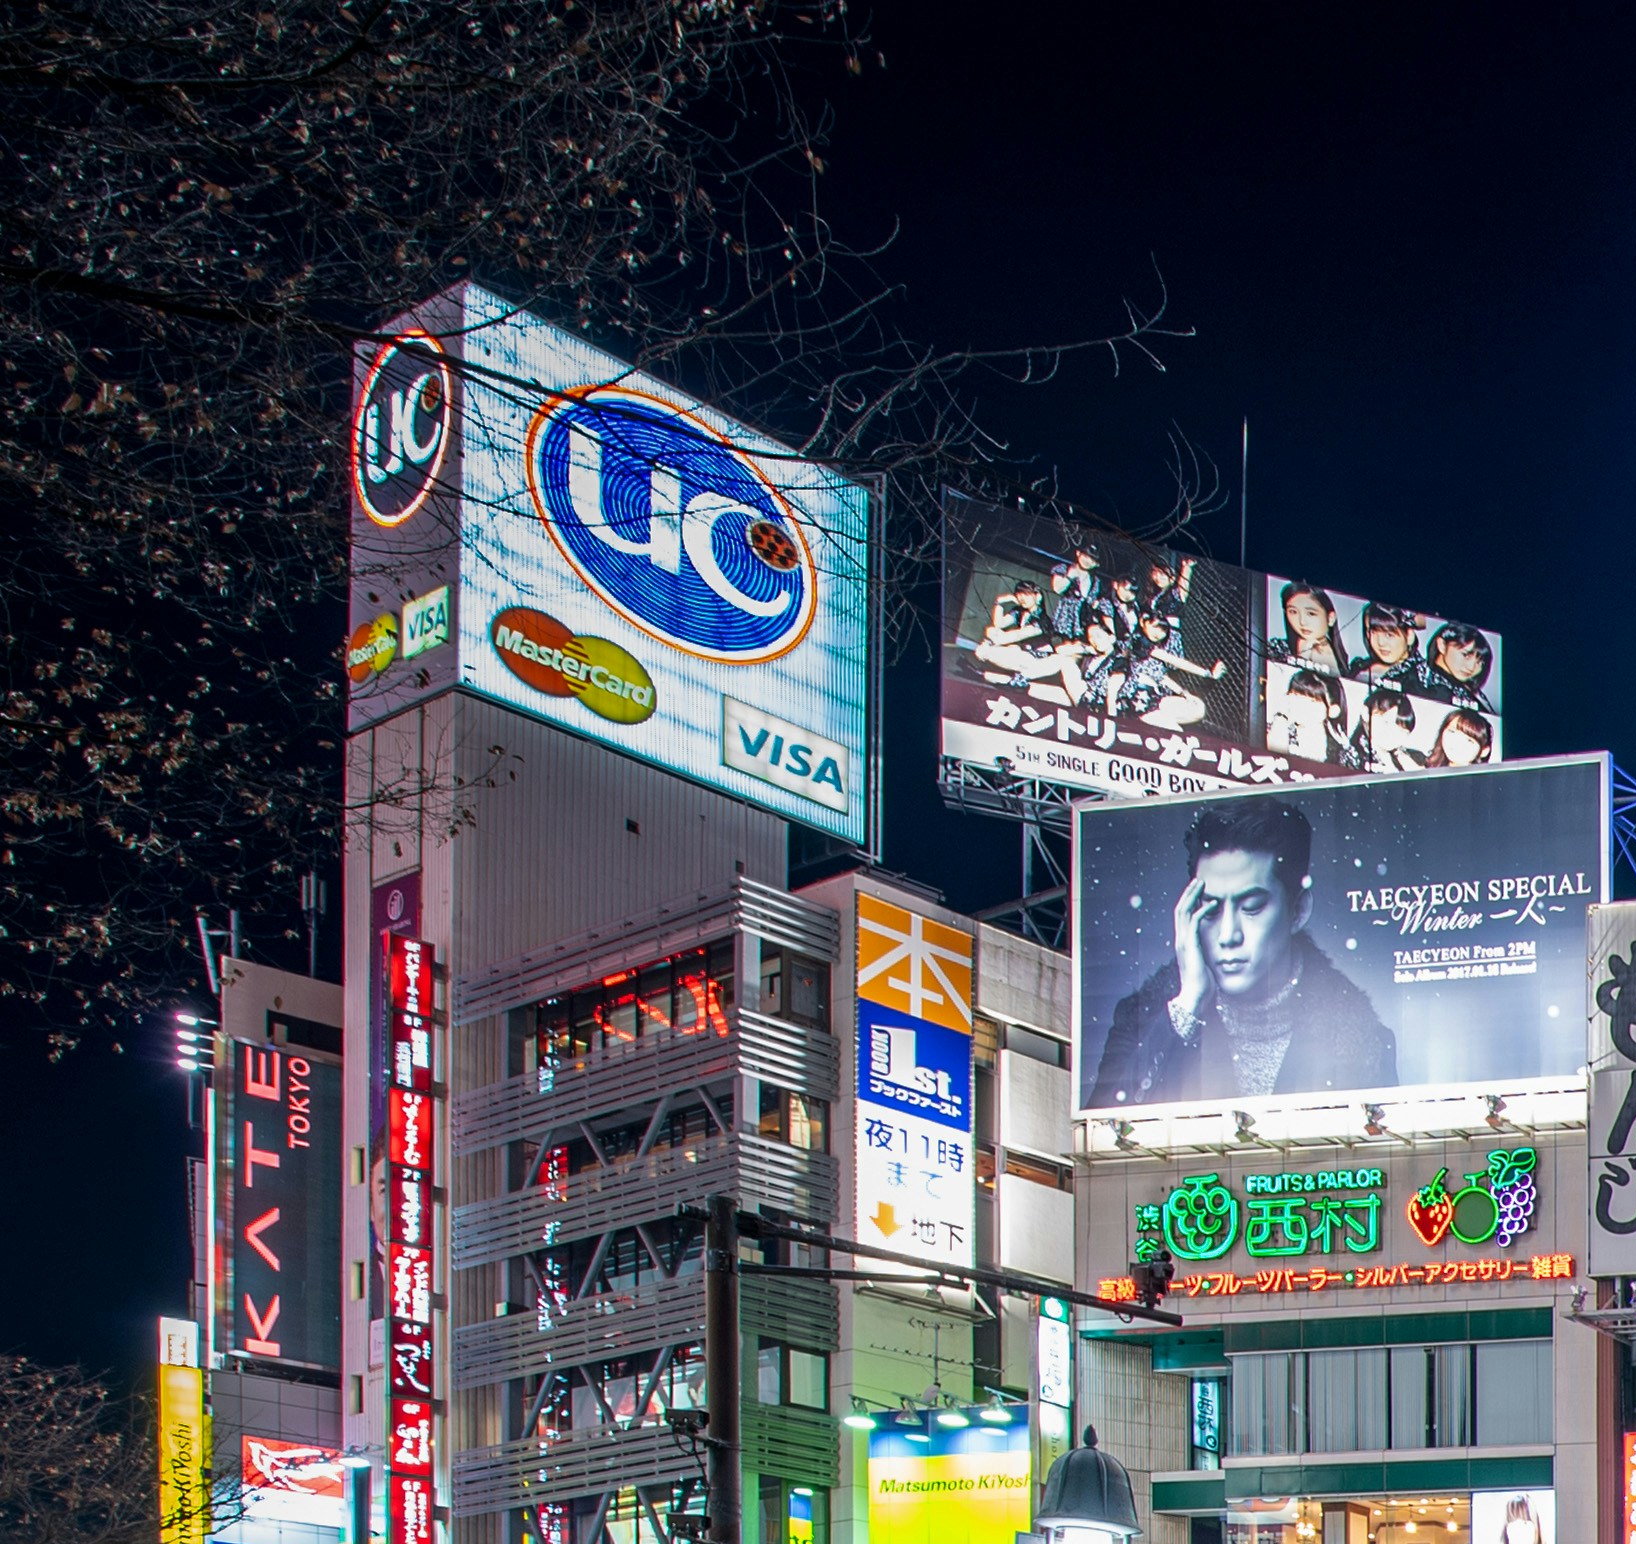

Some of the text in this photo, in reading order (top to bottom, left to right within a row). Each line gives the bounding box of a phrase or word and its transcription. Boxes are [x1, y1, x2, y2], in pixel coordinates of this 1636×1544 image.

[366, 372, 443, 484] UC
[568, 414, 791, 618] UC
[408, 610, 449, 644] VISA
[494, 624, 654, 710] MasterCard
[736, 722, 846, 794] VISA
[1046, 752, 1101, 778] SINGLE
[1107, 758, 1162, 789] GOOD
[1346, 872, 1592, 913] TAECYEON SPECIAL
[857, 911, 974, 1027] 本
[1393, 940, 1537, 964] TAECYEON From 2PM
[287, 1057, 311, 1150] TOKYO
[868, 1079, 963, 1119] ブックファースト
[243, 1045, 281, 1358] KATE
[1245, 1192, 1383, 1258] 西村
[879, 1477, 975, 1494] Matsumoto
